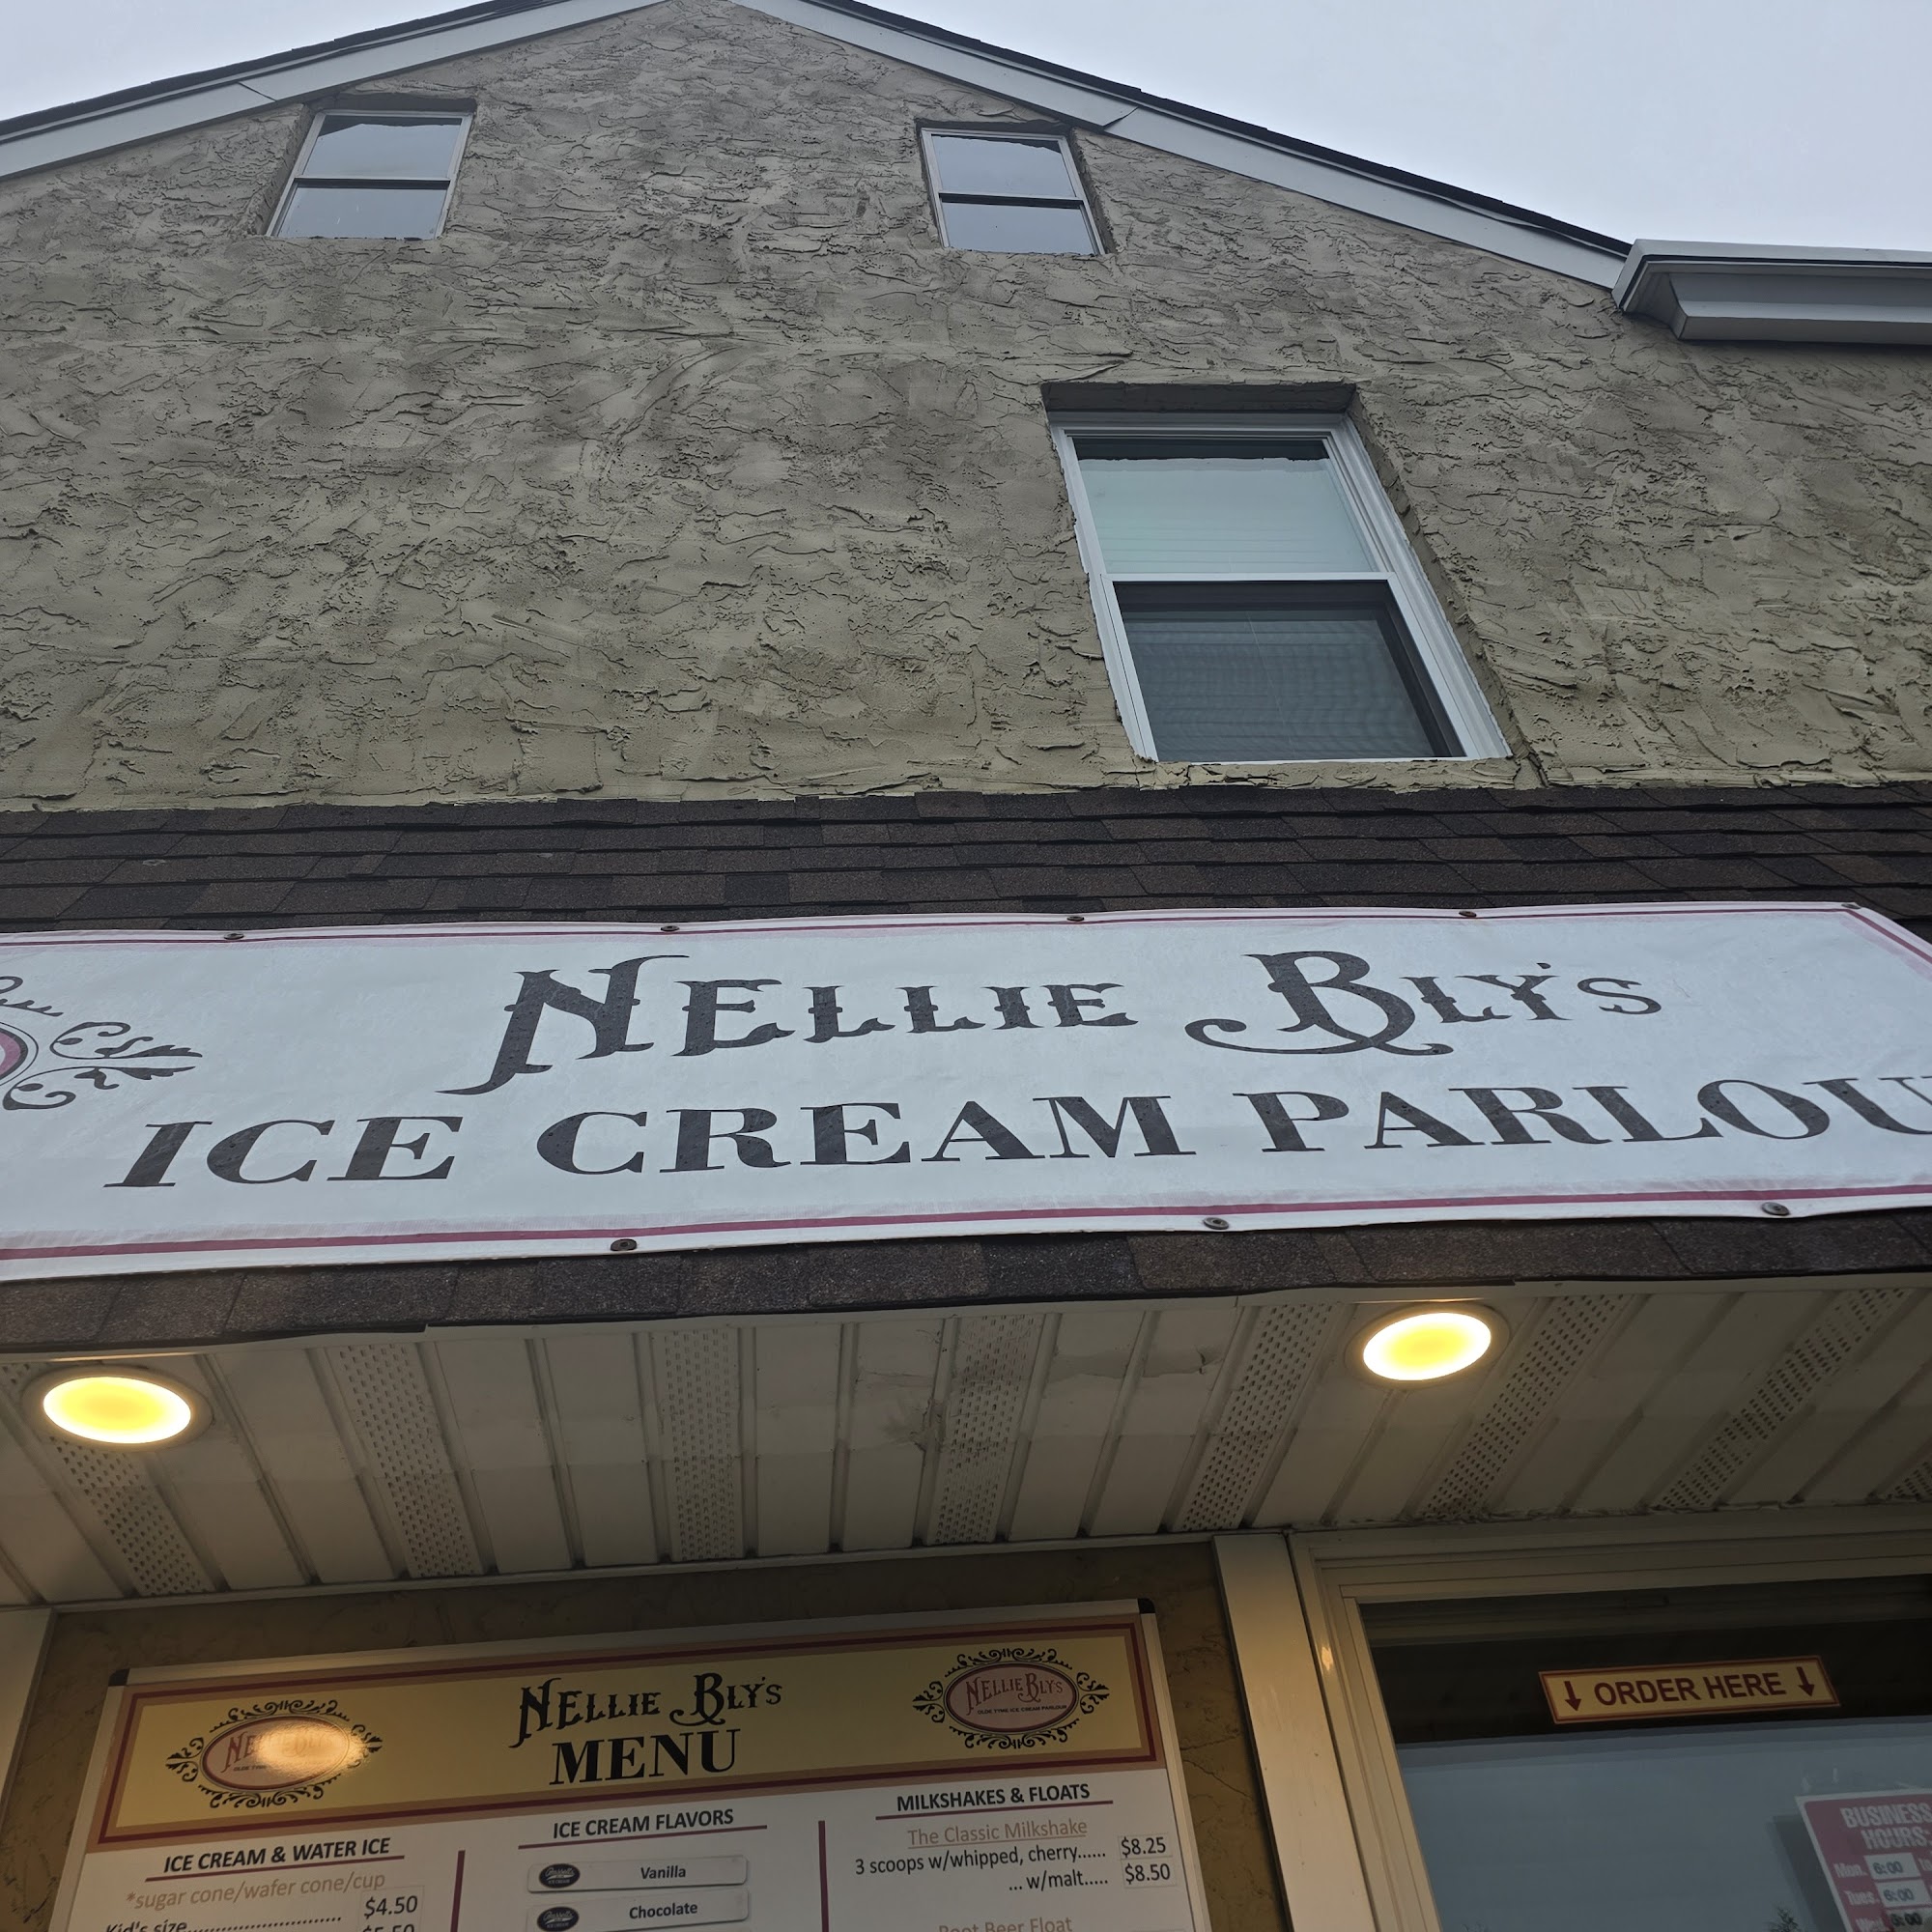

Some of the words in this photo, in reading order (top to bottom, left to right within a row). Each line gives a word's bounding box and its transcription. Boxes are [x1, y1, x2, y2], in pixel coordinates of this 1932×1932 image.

[438, 954, 1139, 1096] NELLIE
[1184, 950, 1662, 1056] BLY'S
[103, 1115, 464, 1187] ICE
[536, 1094, 1197, 1176] CREAM
[1233, 1076, 1932, 1152] PARLOU
[966, 1676, 1024, 1716] NELLIE
[1017, 1672, 1064, 1703] BLY'S
[1594, 1677, 1702, 1706] ORDER
[1703, 1672, 1786, 1700] HERE
[508, 1677, 662, 1748] NELLIE
[669, 1672, 782, 1726] BLY'S
[549, 1728, 741, 1785] MENU
[897, 1789, 1006, 1811] MILKSHAKES
[1010, 1787, 1025, 1804] &
[1029, 1783, 1091, 1803] FLOATS
[554, 1821, 580, 1838] ICE
[585, 1816, 650, 1835] CREAM
[656, 1809, 734, 1831] FLAVORS
[1839, 1803, 1932, 1828] BUSINESS
[907, 1829, 939, 1845] The
[945, 1825, 1000, 1843] Classic
[1005, 1818, 1088, 1838] Milkshake
[163, 1855, 194, 1873] ICE
[198, 1848, 267, 1870] CREAM
[270, 1846, 286, 1863] &
[293, 1840, 356, 1861] WATER
[362, 1837, 390, 1856] ICE
[855, 1859, 865, 1875] 3
[869, 1857, 924, 1875] scoops
[928, 1846, 1024, 1872] w/whipped,
[1122, 1836, 1166, 1858] $8.25
[640, 1865, 686, 1880] Vanilla
[1124, 1863, 1171, 1885] $8.50
[190, 1879, 297, 1904] cone/wafer
[300, 1871, 385, 1893] cone/cup
[364, 1895, 417, 1919] $4.50
[629, 1903, 698, 1919] Chocolate
[1030, 1917, 1072, 1932] Float
